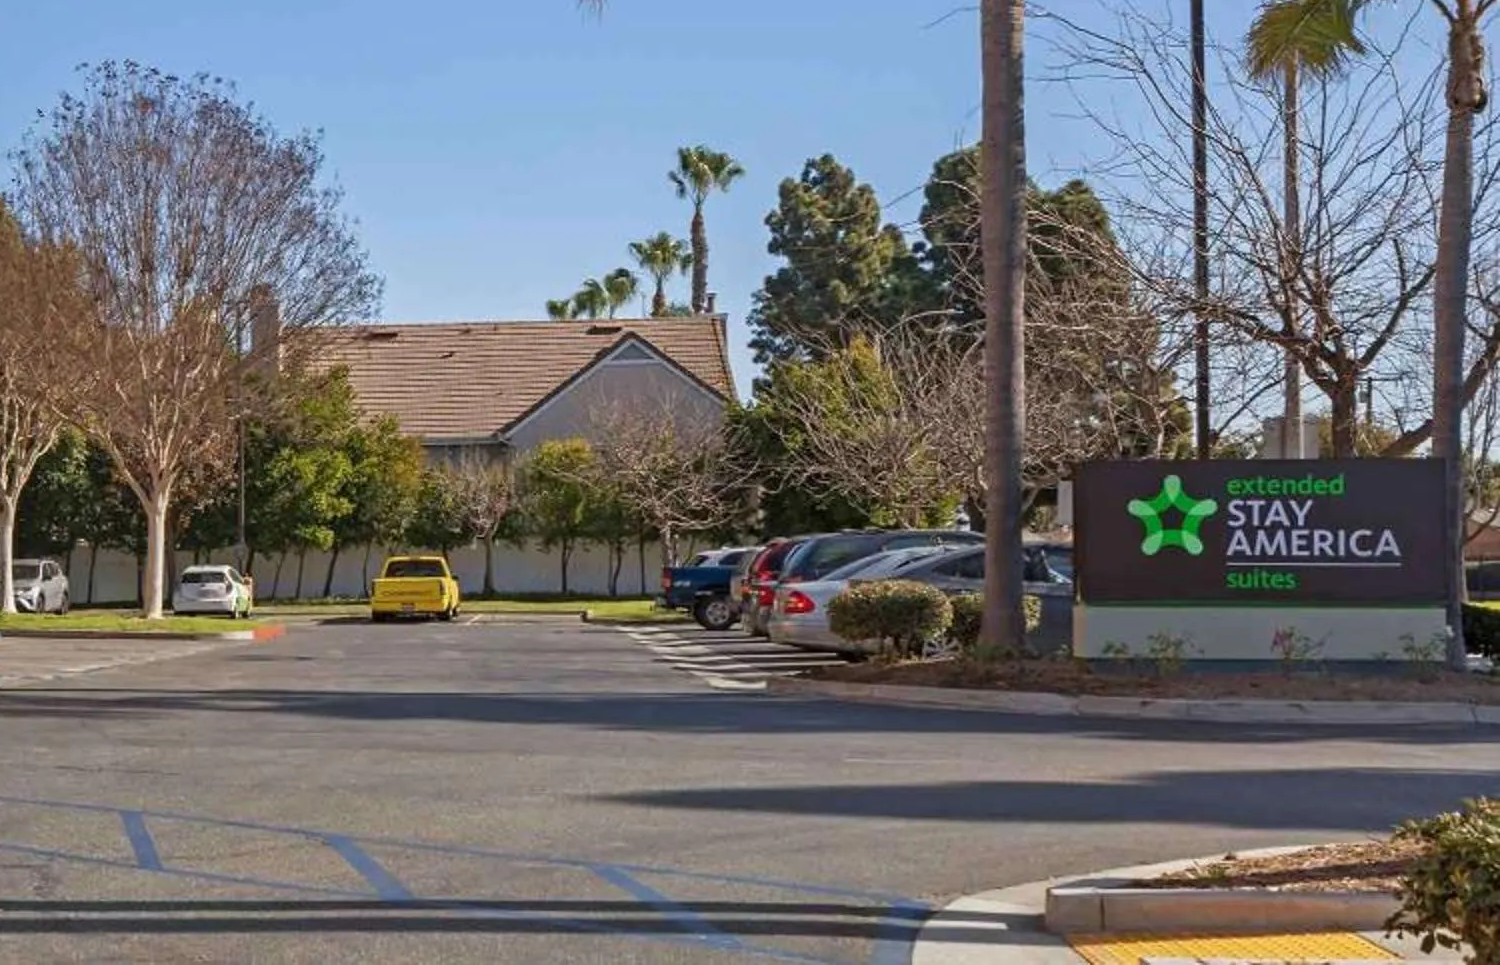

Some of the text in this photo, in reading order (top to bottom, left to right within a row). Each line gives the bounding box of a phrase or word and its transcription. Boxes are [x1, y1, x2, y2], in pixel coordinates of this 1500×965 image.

[1227, 474, 1344, 495] extended
[1227, 499, 1313, 526] STAY
[1226, 529, 1401, 557] AMERICA
[1226, 568, 1296, 589] suites
